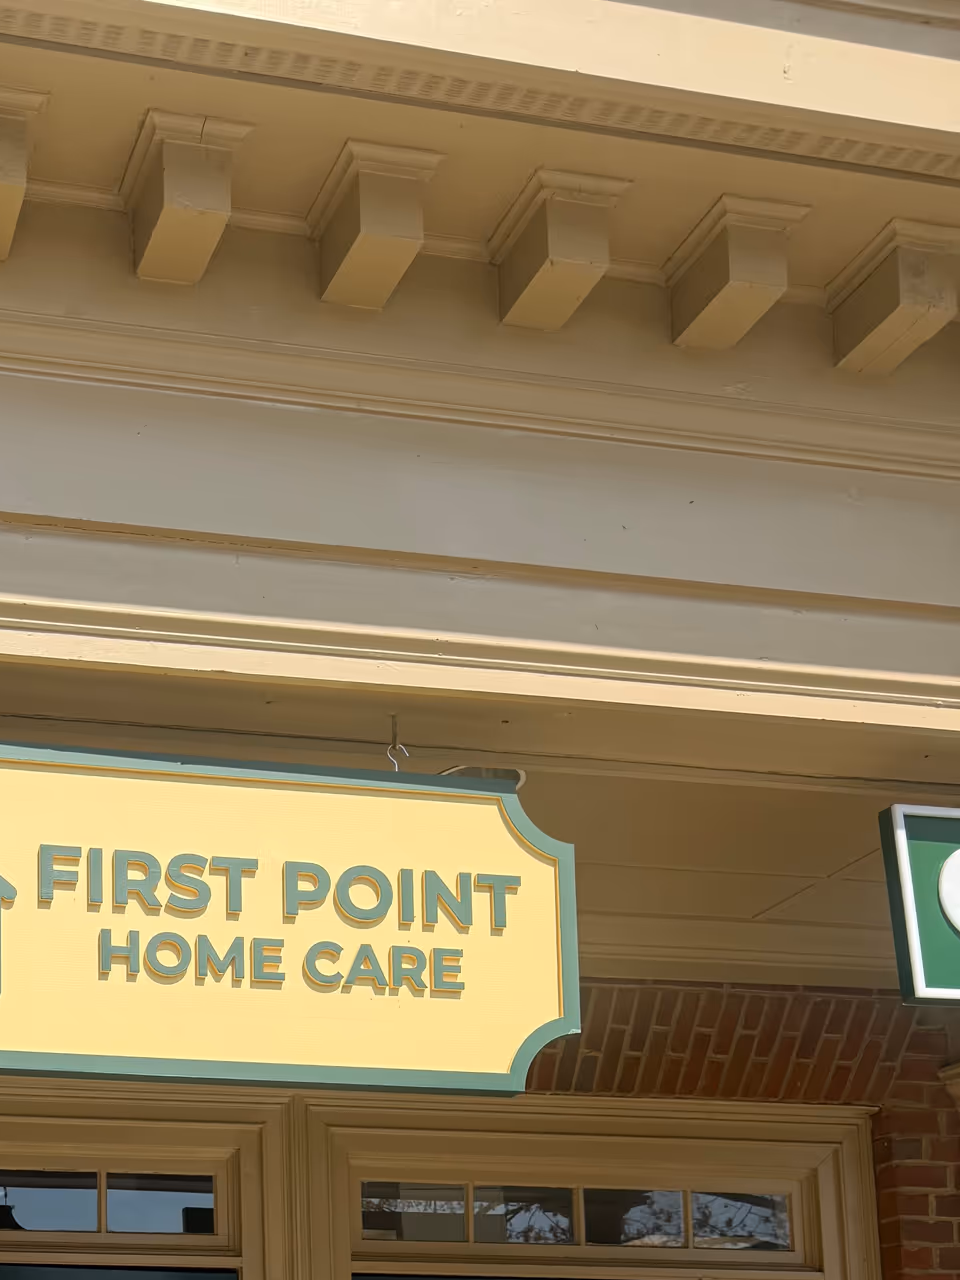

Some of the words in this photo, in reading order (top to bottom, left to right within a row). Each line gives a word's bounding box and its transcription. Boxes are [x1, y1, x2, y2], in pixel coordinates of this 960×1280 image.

[38, 844, 259, 915] FIRST
[283, 861, 522, 930] POINT
[98, 928, 286, 984] HOME
[302, 941, 466, 992] CARE
